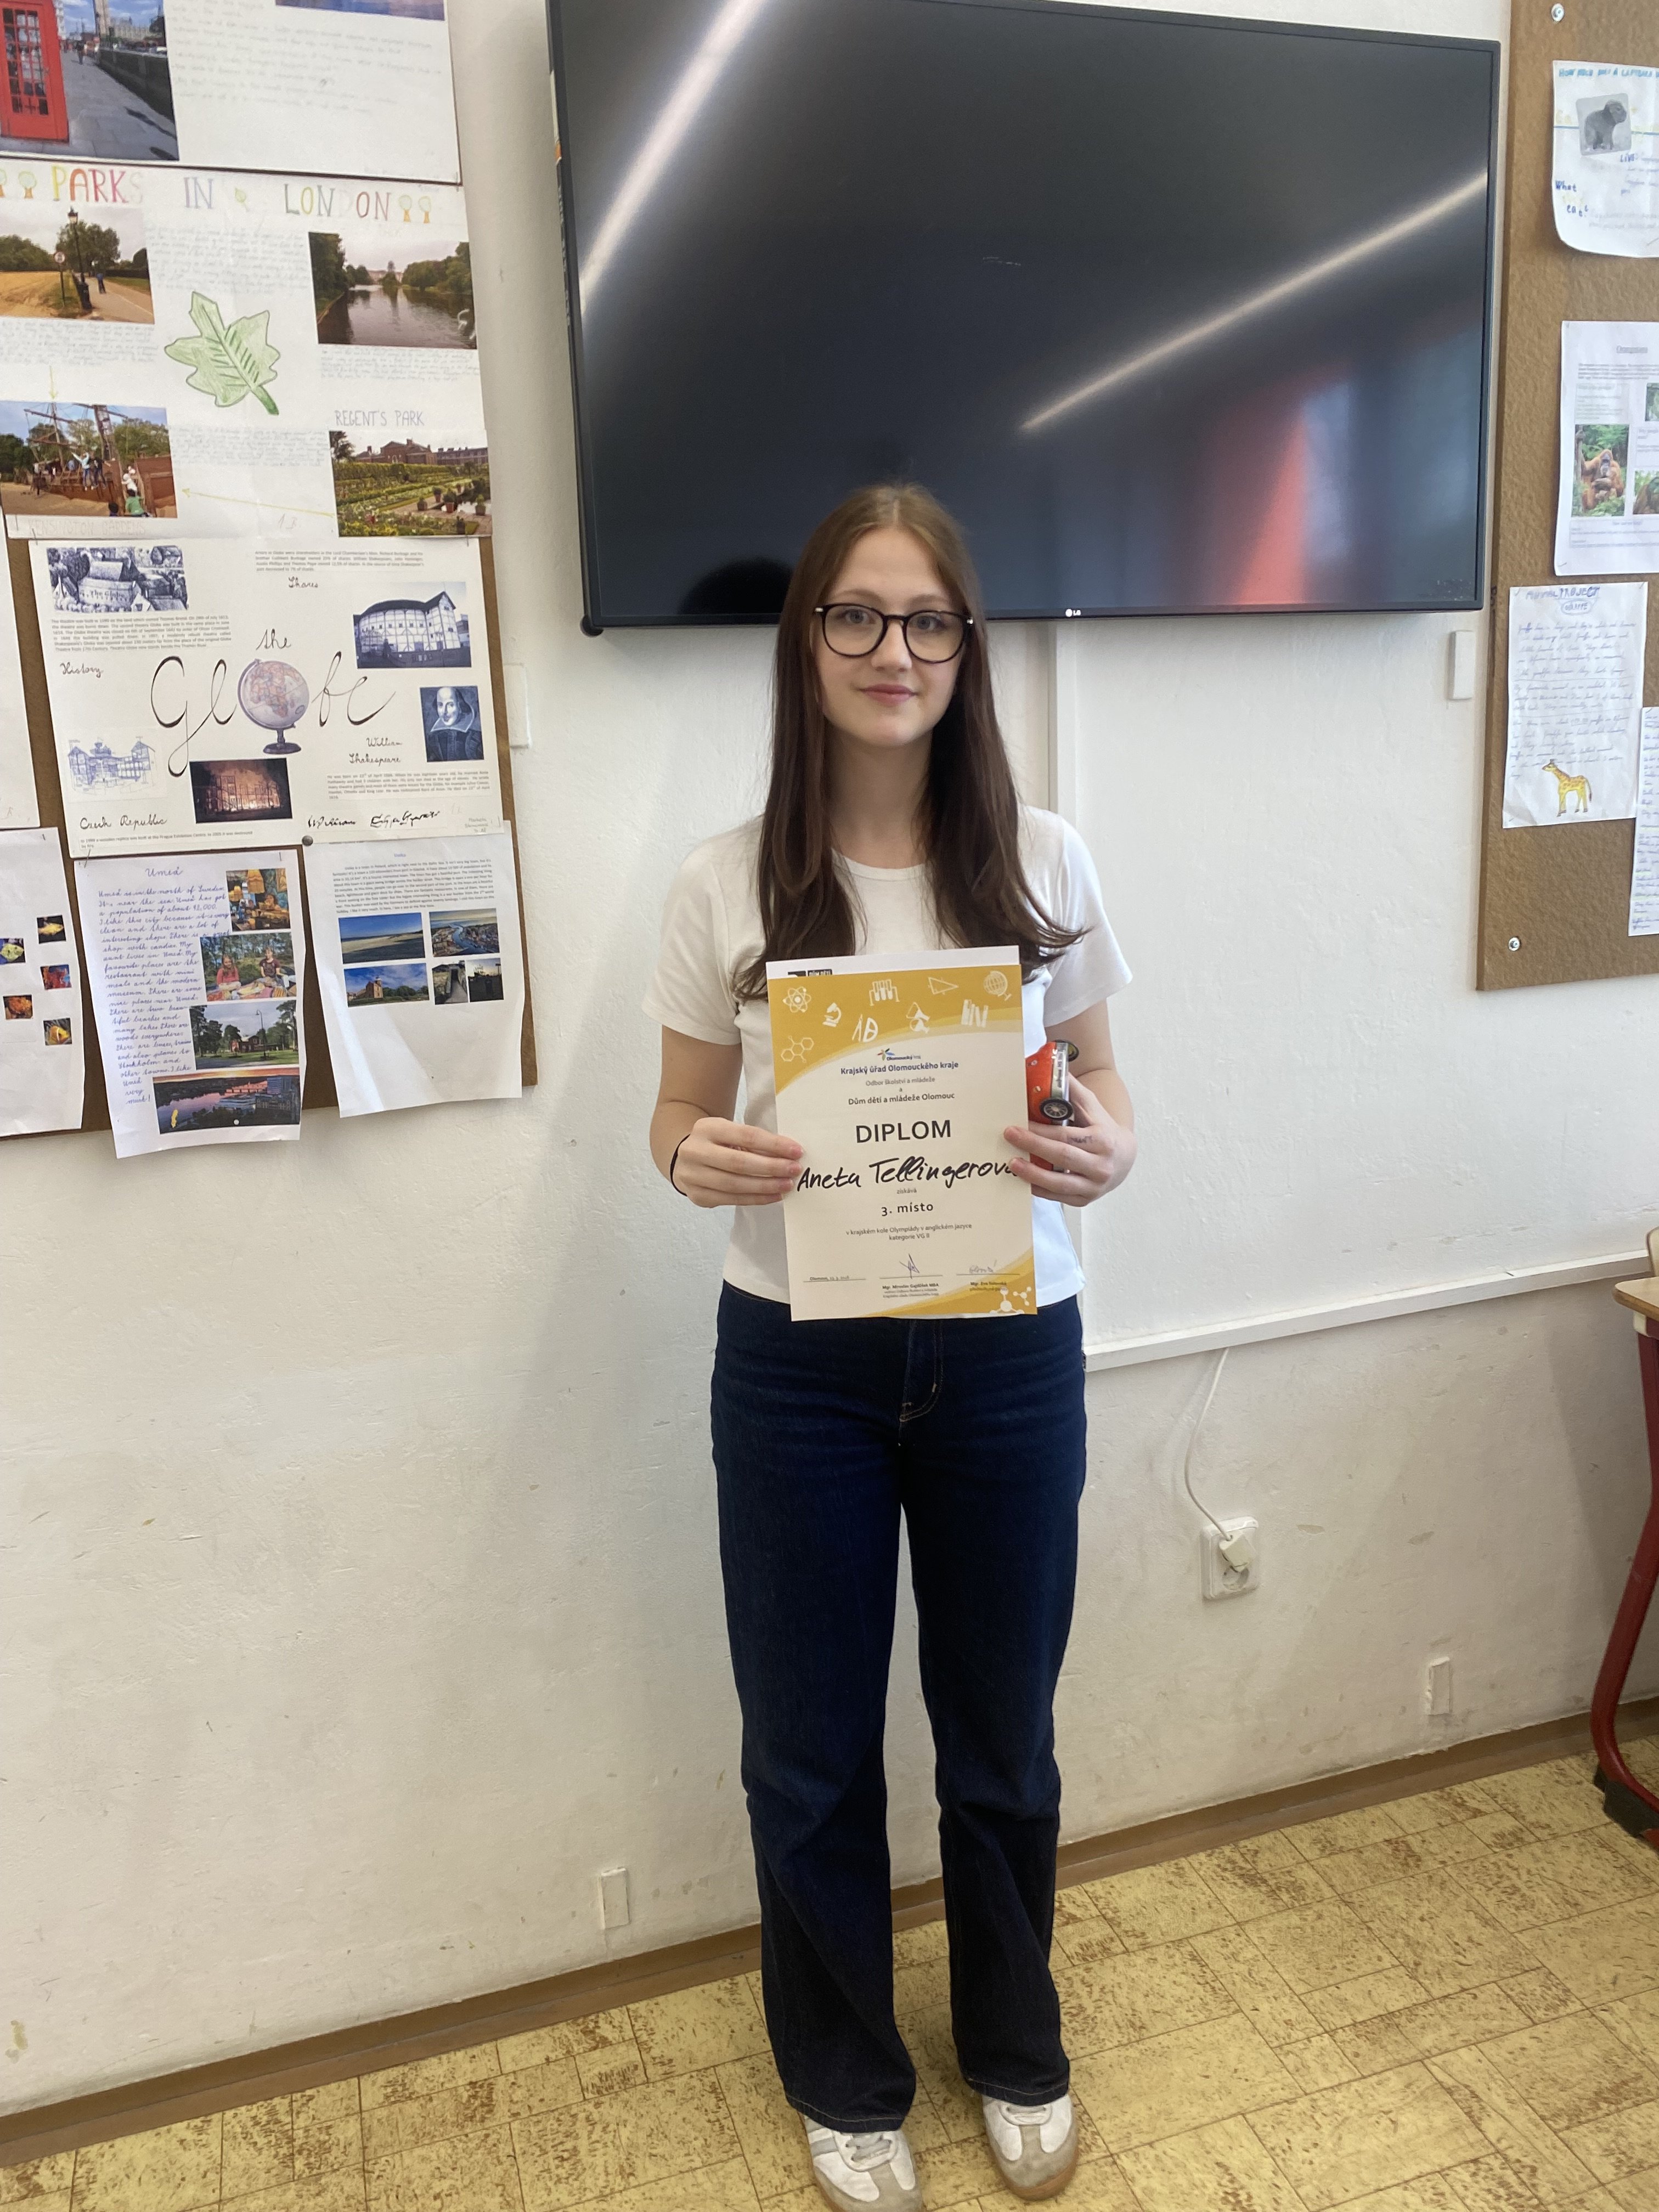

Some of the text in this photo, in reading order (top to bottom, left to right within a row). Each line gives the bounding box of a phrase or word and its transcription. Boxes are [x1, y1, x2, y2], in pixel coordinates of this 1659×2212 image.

[52, 166, 391, 221] PARKS IN LONDON
[394, 410, 424, 426] PARK
[1560, 586, 1600, 598] PROJECT
[60, 662, 103, 678] History
[366, 737, 402, 748] William
[349, 753, 401, 766] Shakespeare
[80, 815, 167, 830] Czech Republic
[145, 866, 183, 877] Umeå
[99, 889, 122, 897] Umeå
[187, 886, 195, 894] of
[215, 894, 226, 902] got
[110, 908, 154, 917] population
[157, 906, 165, 915] of
[150, 924, 171, 932] there
[211, 921, 219, 929] of
[142, 961, 163, 969] places
[154, 1051, 177, 1059] planes
[119, 1059, 160, 1069] Stockholm
[840, 1066, 867, 1075] Krajský
[888, 1062, 938, 1071] Olomouckého
[889, 1094, 920, 1103] mládeže
[856, 1120, 951, 1143] DIPLOM
[797, 1167, 861, 1192] Aneta
[881, 1202, 934, 1216] 3. místo
[889, 1226, 919, 1234] Olympiády
[925, 1224, 953, 1232] anglickém
